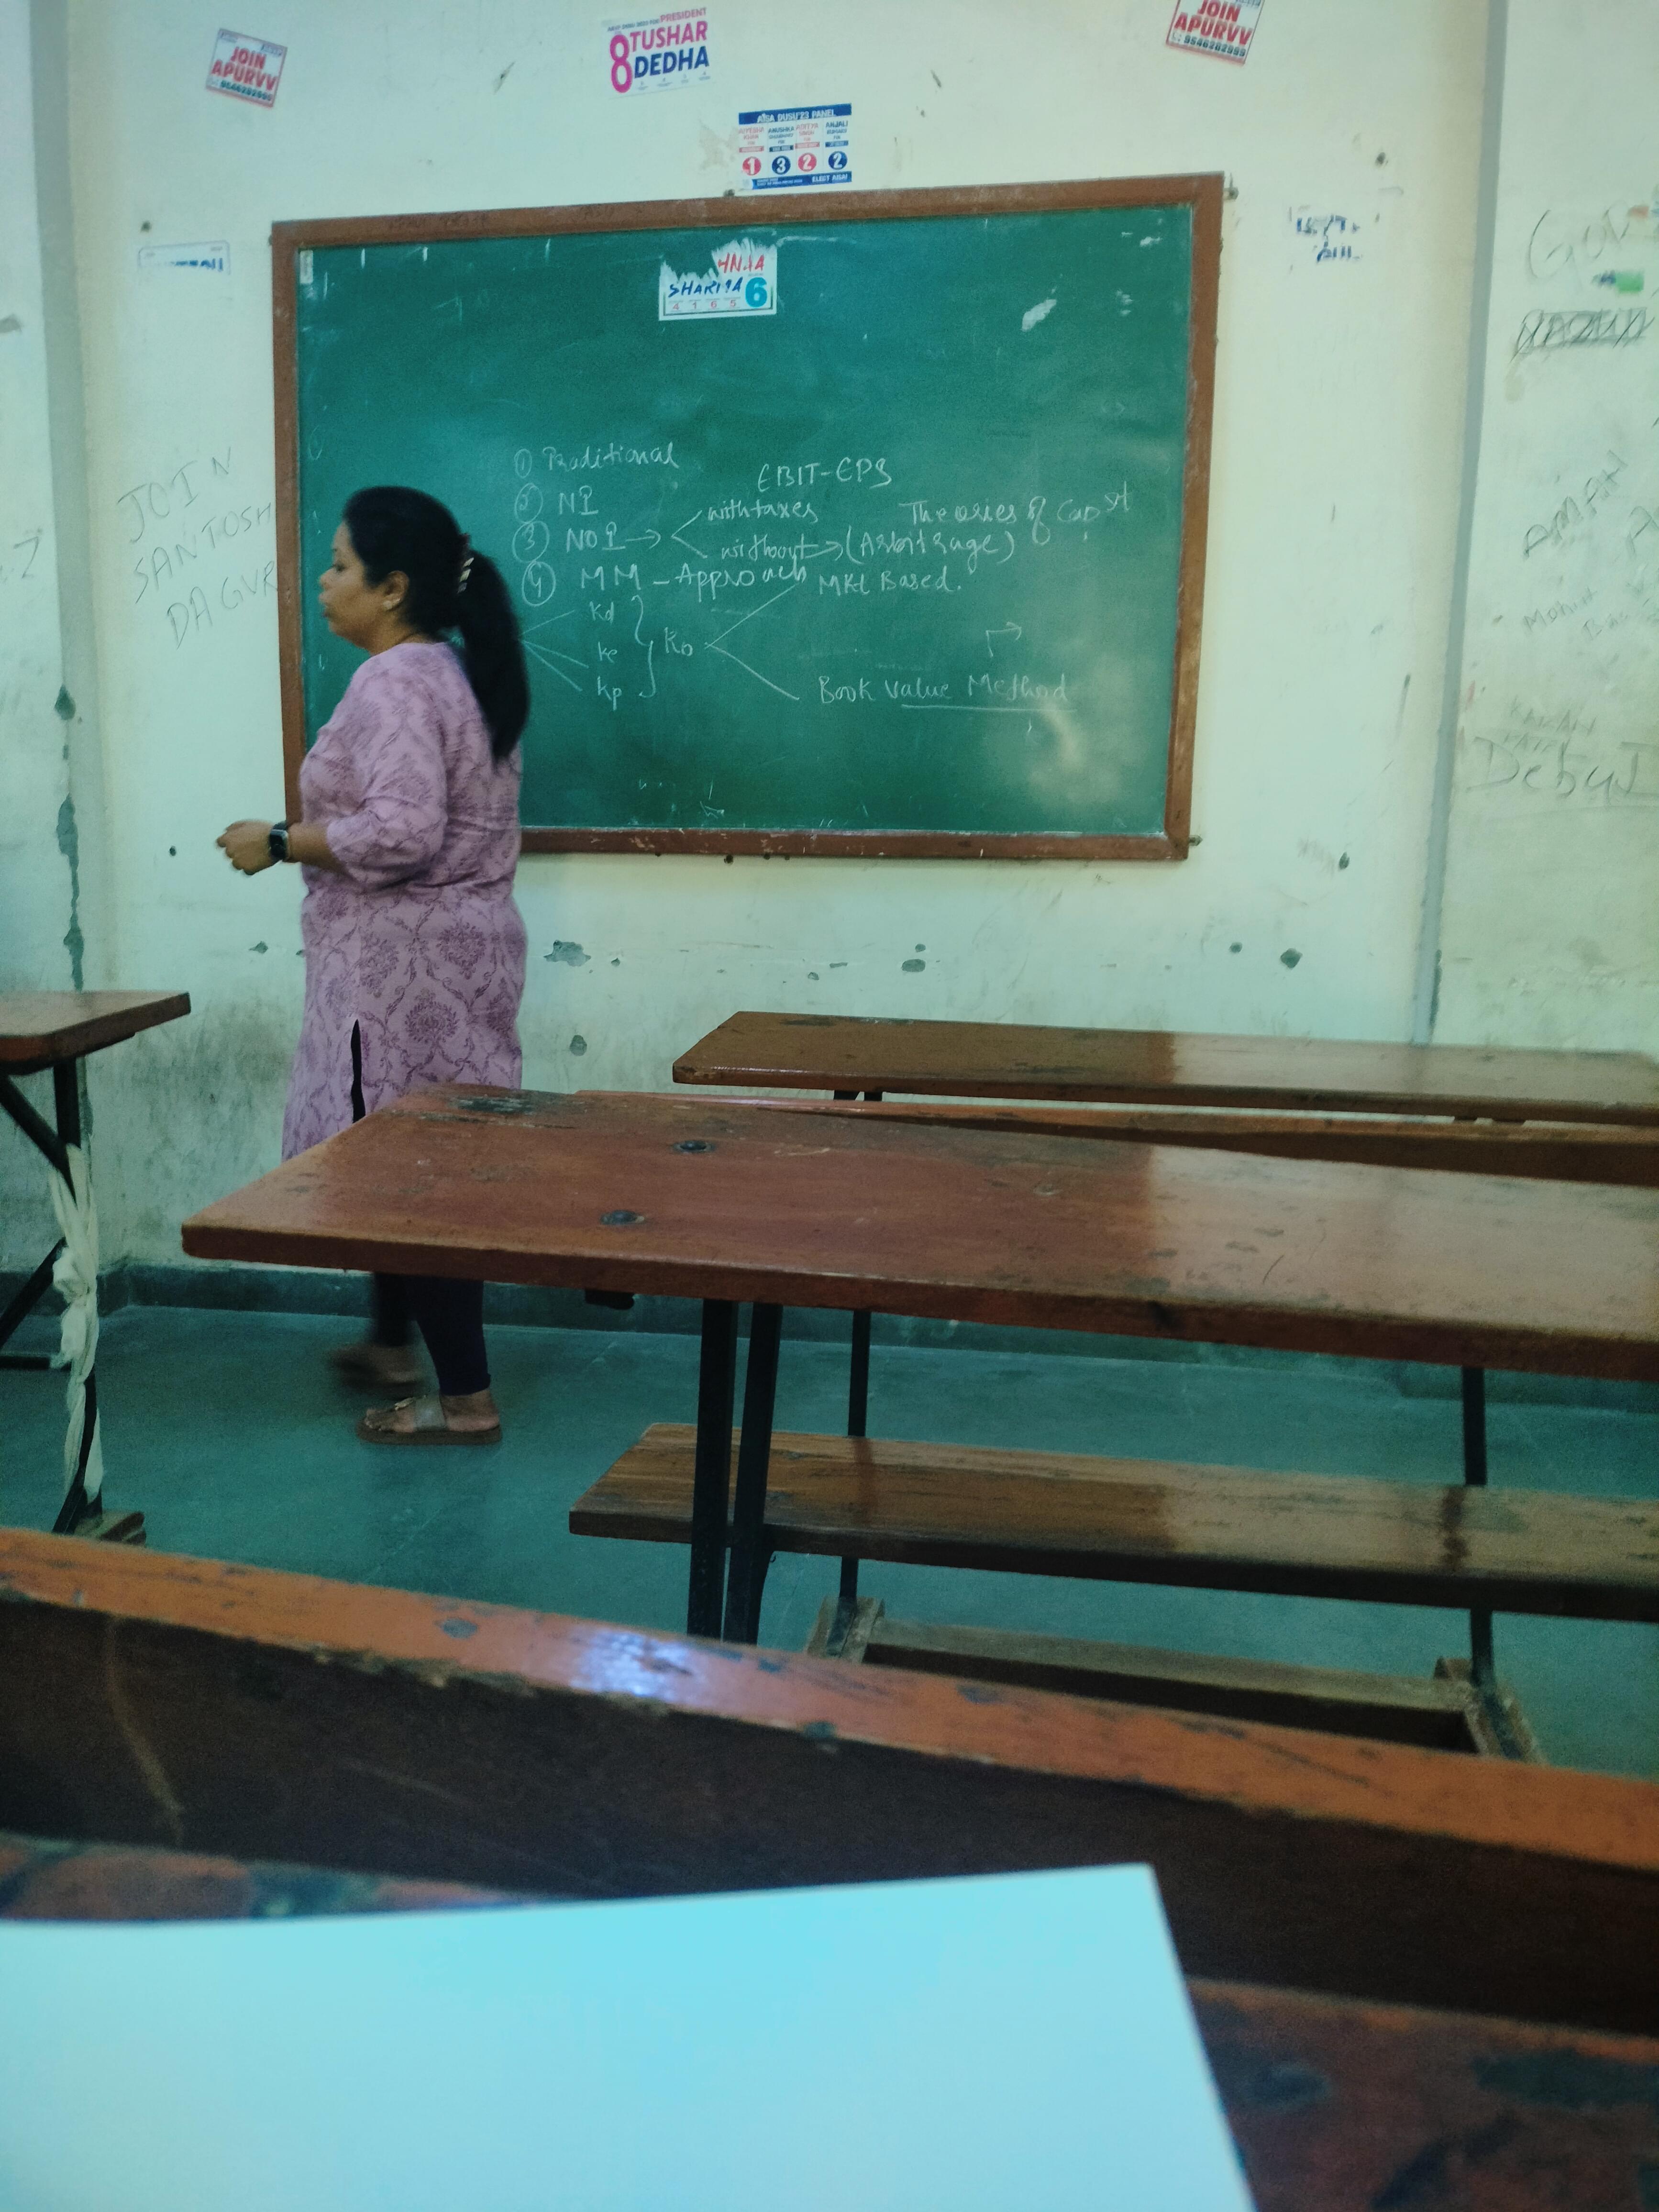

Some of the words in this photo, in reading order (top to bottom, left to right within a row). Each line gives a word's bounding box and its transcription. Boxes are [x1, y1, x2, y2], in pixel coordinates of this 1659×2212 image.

[660, 7, 707, 22] PRESIDENT
[1197, 0, 1242, 22] JOIN
[630, 21, 708, 52] TUSHAR
[1174, 12, 1254, 45] APURVV
[230, 46, 266, 69] JOIN
[609, 34, 633, 93] 8
[634, 46, 709, 78] DEDHA
[211, 59, 278, 90] APURVV
[812, 109, 834, 119] PANEL
[776, 157, 786, 173] 3
[803, 155, 812, 170] 2
[833, 153, 843, 168] 2
[745, 276, 768, 308] 6
[116, 446, 231, 544] JOIN
[133, 502, 271, 605] SANTOSH
